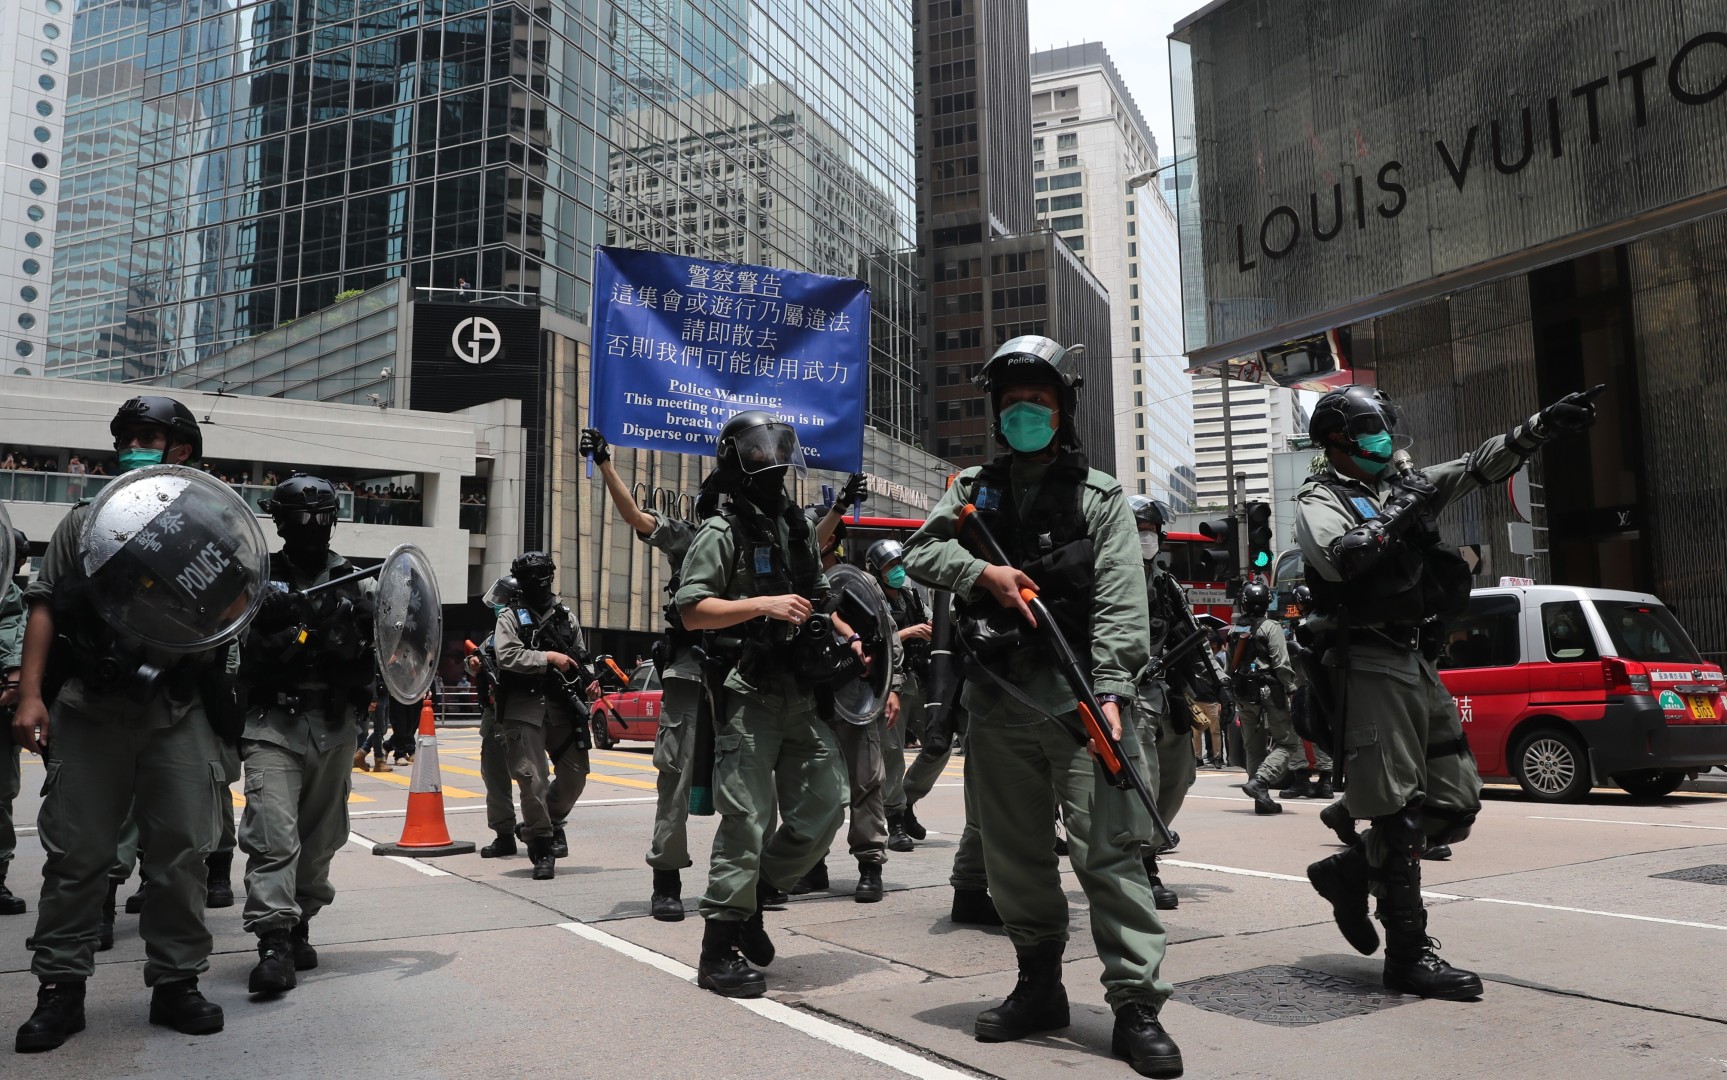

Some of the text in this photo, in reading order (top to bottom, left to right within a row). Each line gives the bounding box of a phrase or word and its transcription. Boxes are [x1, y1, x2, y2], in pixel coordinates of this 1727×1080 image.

[1237, 161, 1407, 273] LOUIS
[687, 264, 782, 298] 警察警告
[610, 282, 851, 332] 這集會或遊行乃屬違法
[681, 318, 778, 350] 請即散去
[606, 333, 848, 384] 否則我們可能使用武力
[1008, 356, 1035, 366] Police
[623, 392, 653, 406] This
[656, 398, 709, 415] meeting
[711, 406, 726, 415] or
[799, 413, 809, 424] is
[812, 414, 825, 426] in
[668, 379, 782, 409] Police Warning:
[622, 422, 682, 440] Disperse
[685, 432, 701, 442] or
[666, 412, 713, 429] breach
[896, 484, 929, 511] ARMANI
[135, 511, 185, 553] 警察
[175, 541, 231, 600] POLICE
[1668, 696, 1674, 704] 4
